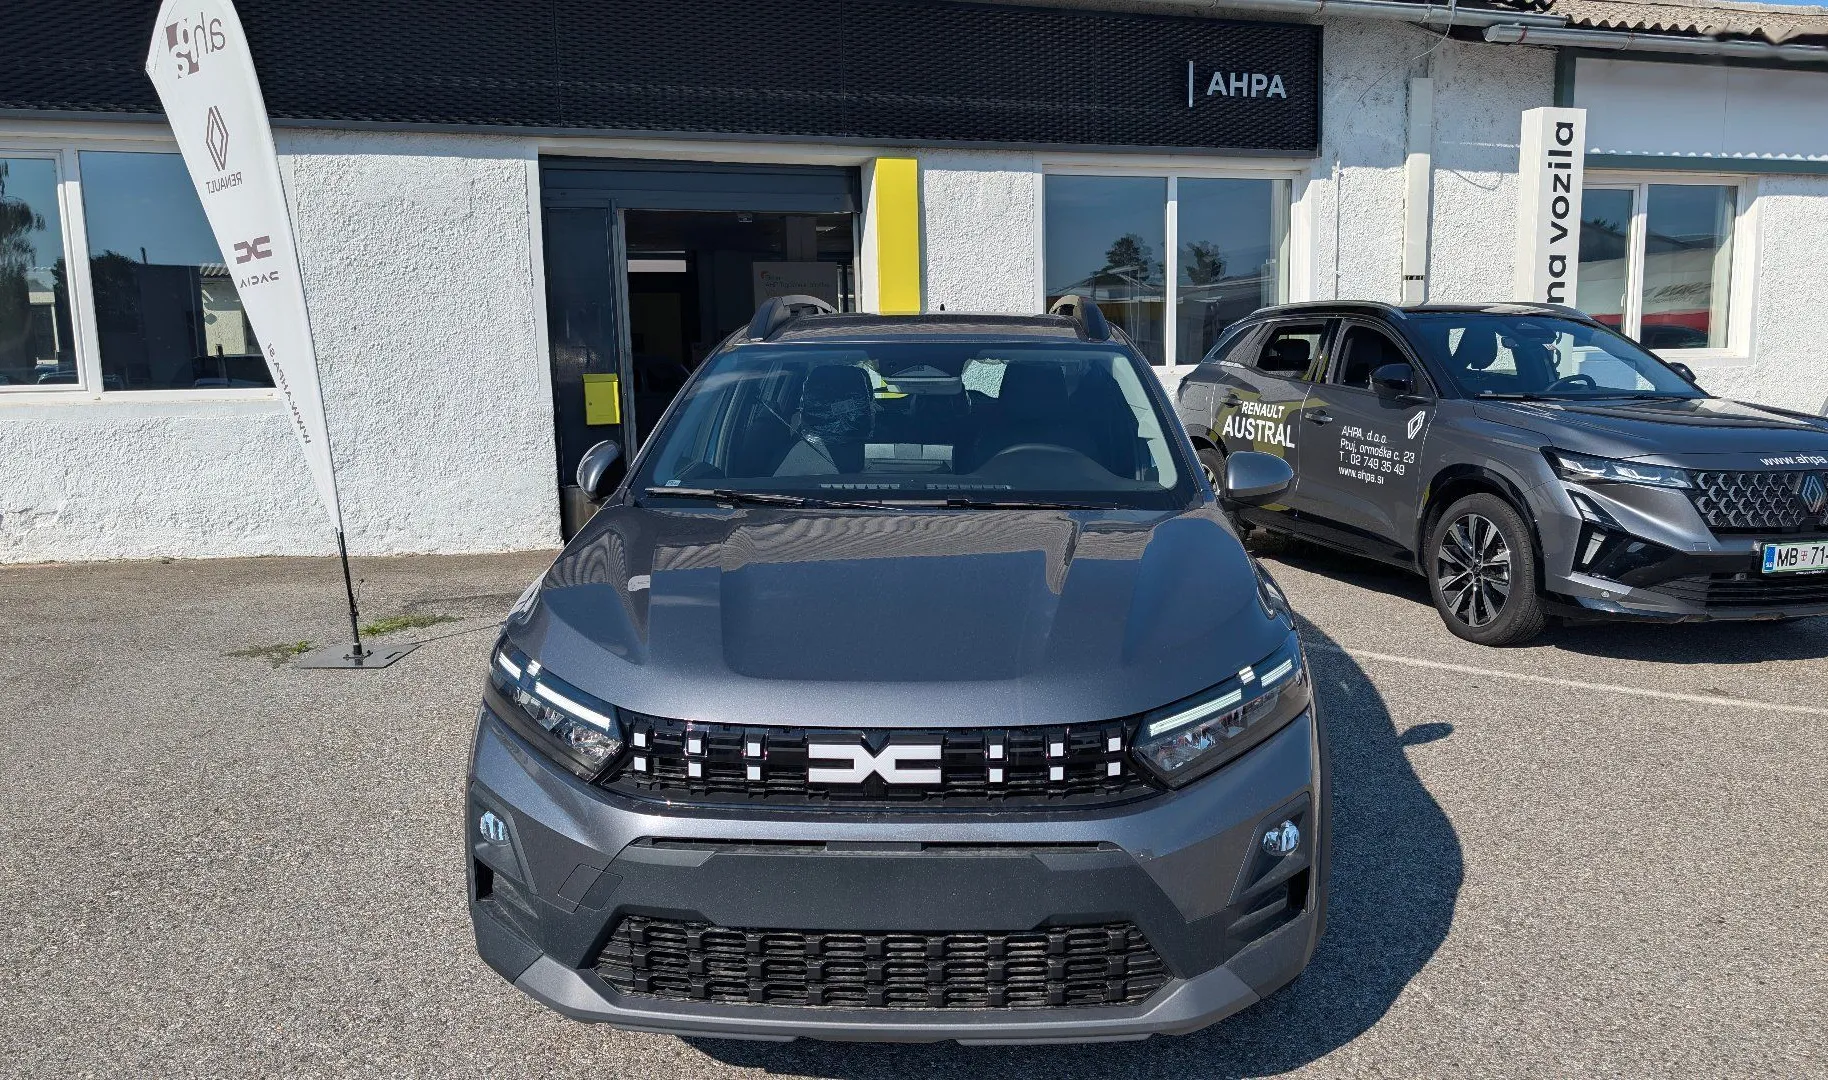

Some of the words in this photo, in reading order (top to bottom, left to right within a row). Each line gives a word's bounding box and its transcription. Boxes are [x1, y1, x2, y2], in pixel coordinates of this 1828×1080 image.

[1206, 71, 1287, 99] AHPA
[1549, 121, 1574, 245] vozila
[1546, 254, 1567, 304] na
[1241, 400, 1285, 419] RENAULT
[1222, 414, 1295, 449] AUSTRAL
[1341, 425, 1364, 441] AHPA,
[1366, 430, 1388, 444] d.o.o.
[1350, 453, 1361, 466] 02
[1363, 456, 1379, 470] 749
[1380, 460, 1392, 473] 35
[1393, 463, 1405, 476] 49
[1403, 451, 1415, 464] 23
[1338, 466, 1384, 485] www.ahpa.si
[1776, 547, 1799, 567] MB
